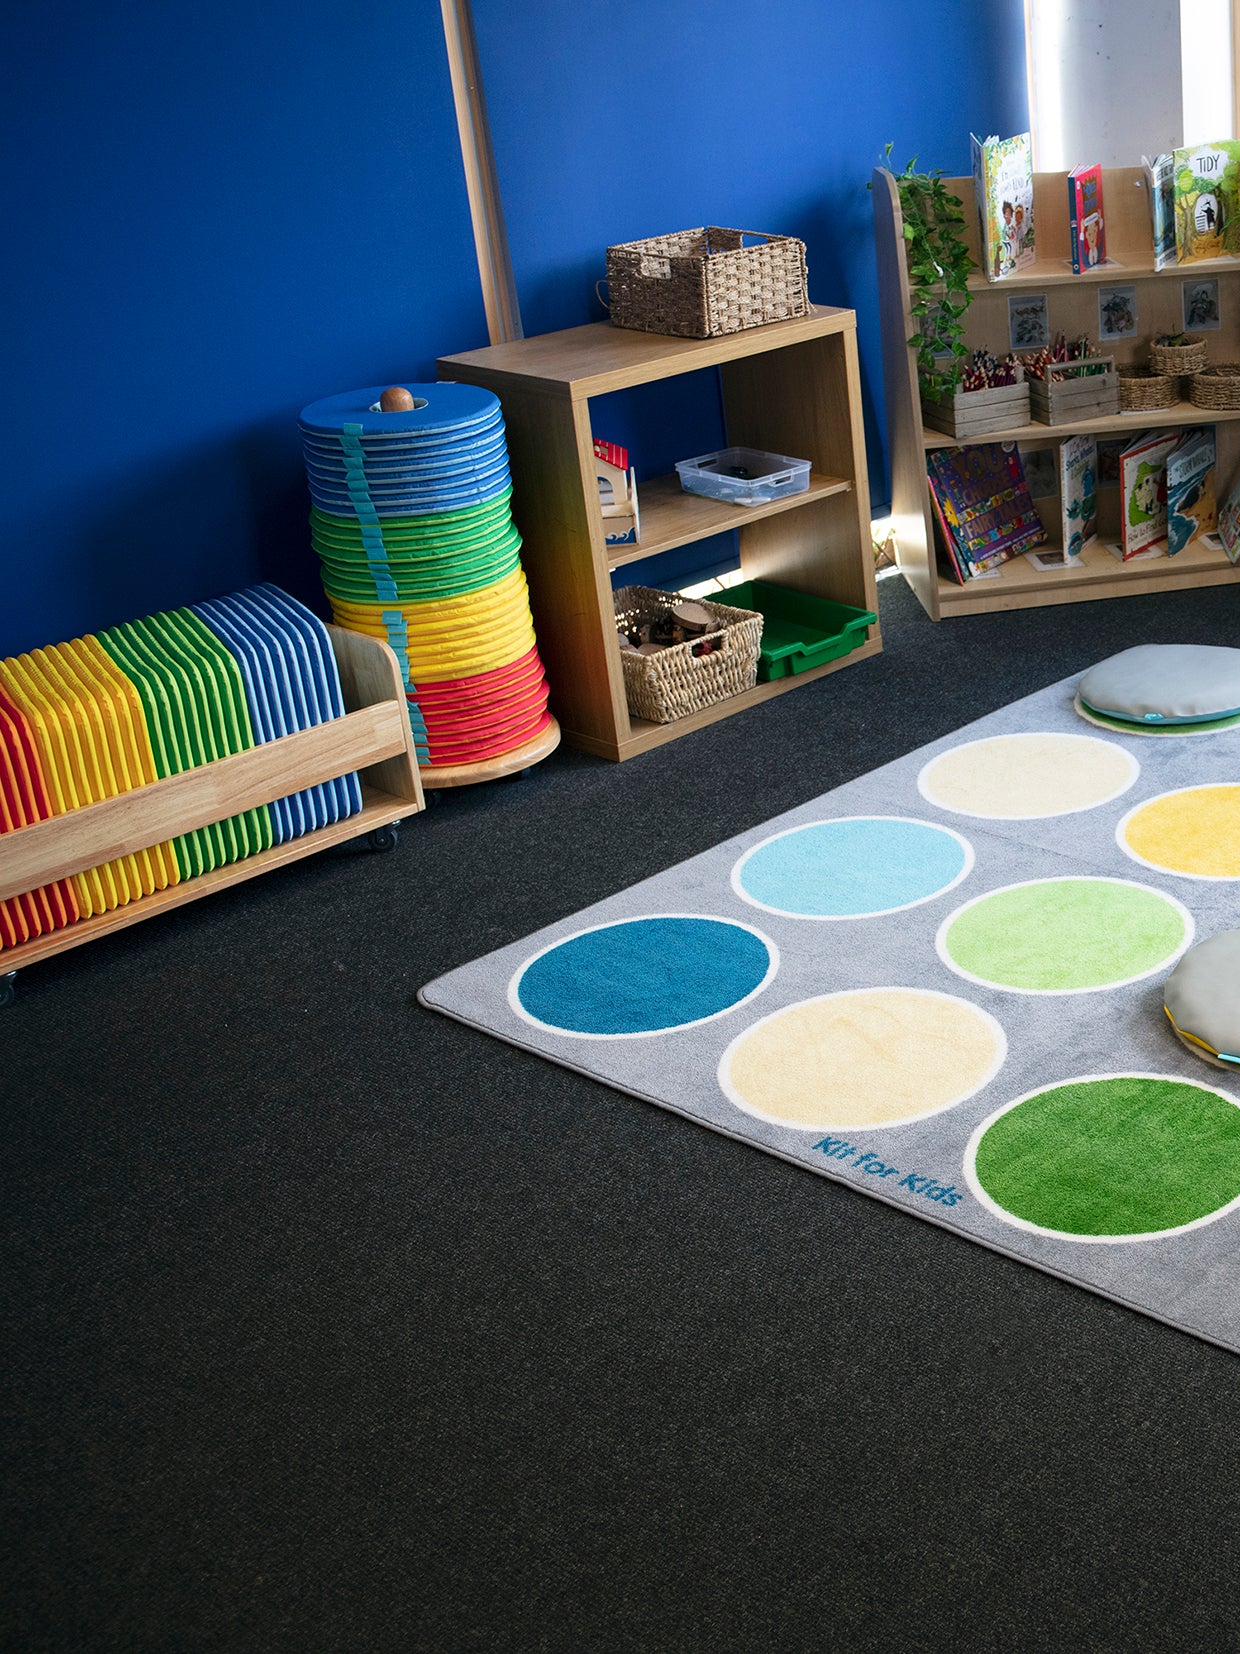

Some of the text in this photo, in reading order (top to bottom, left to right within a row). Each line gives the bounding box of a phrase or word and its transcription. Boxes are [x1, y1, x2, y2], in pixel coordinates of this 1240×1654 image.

[951, 447, 1003, 486] YOU
[812, 1136, 964, 1207] Kit for Kids
